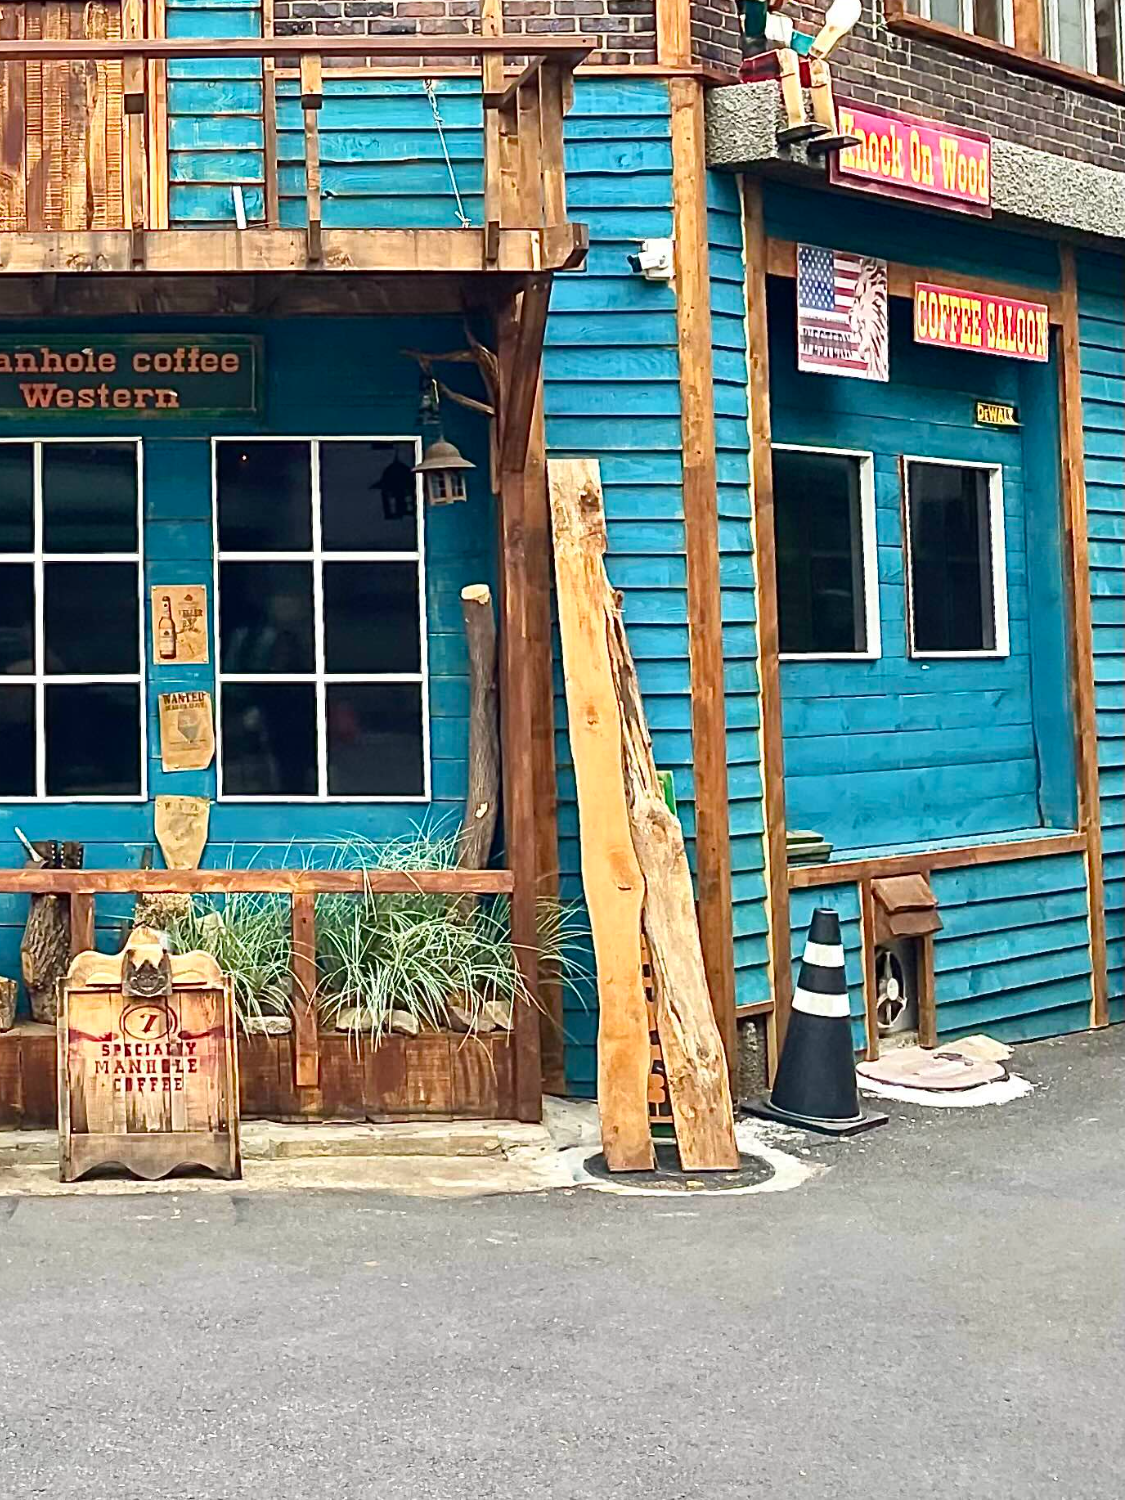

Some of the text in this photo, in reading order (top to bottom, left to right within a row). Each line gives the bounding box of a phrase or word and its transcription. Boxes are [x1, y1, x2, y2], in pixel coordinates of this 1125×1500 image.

[839, 113, 989, 199] Knock On Wood
[918, 290, 1047, 357] COFFEE SALOON
[132, 348, 240, 373] coffee
[19, 383, 180, 408] Western
[162, 691, 206, 705] WANTED
[102, 1042, 197, 1056] SPECIALTY
[95, 1059, 197, 1074] MANHOLE
[114, 1077, 183, 1091] COFFEE
